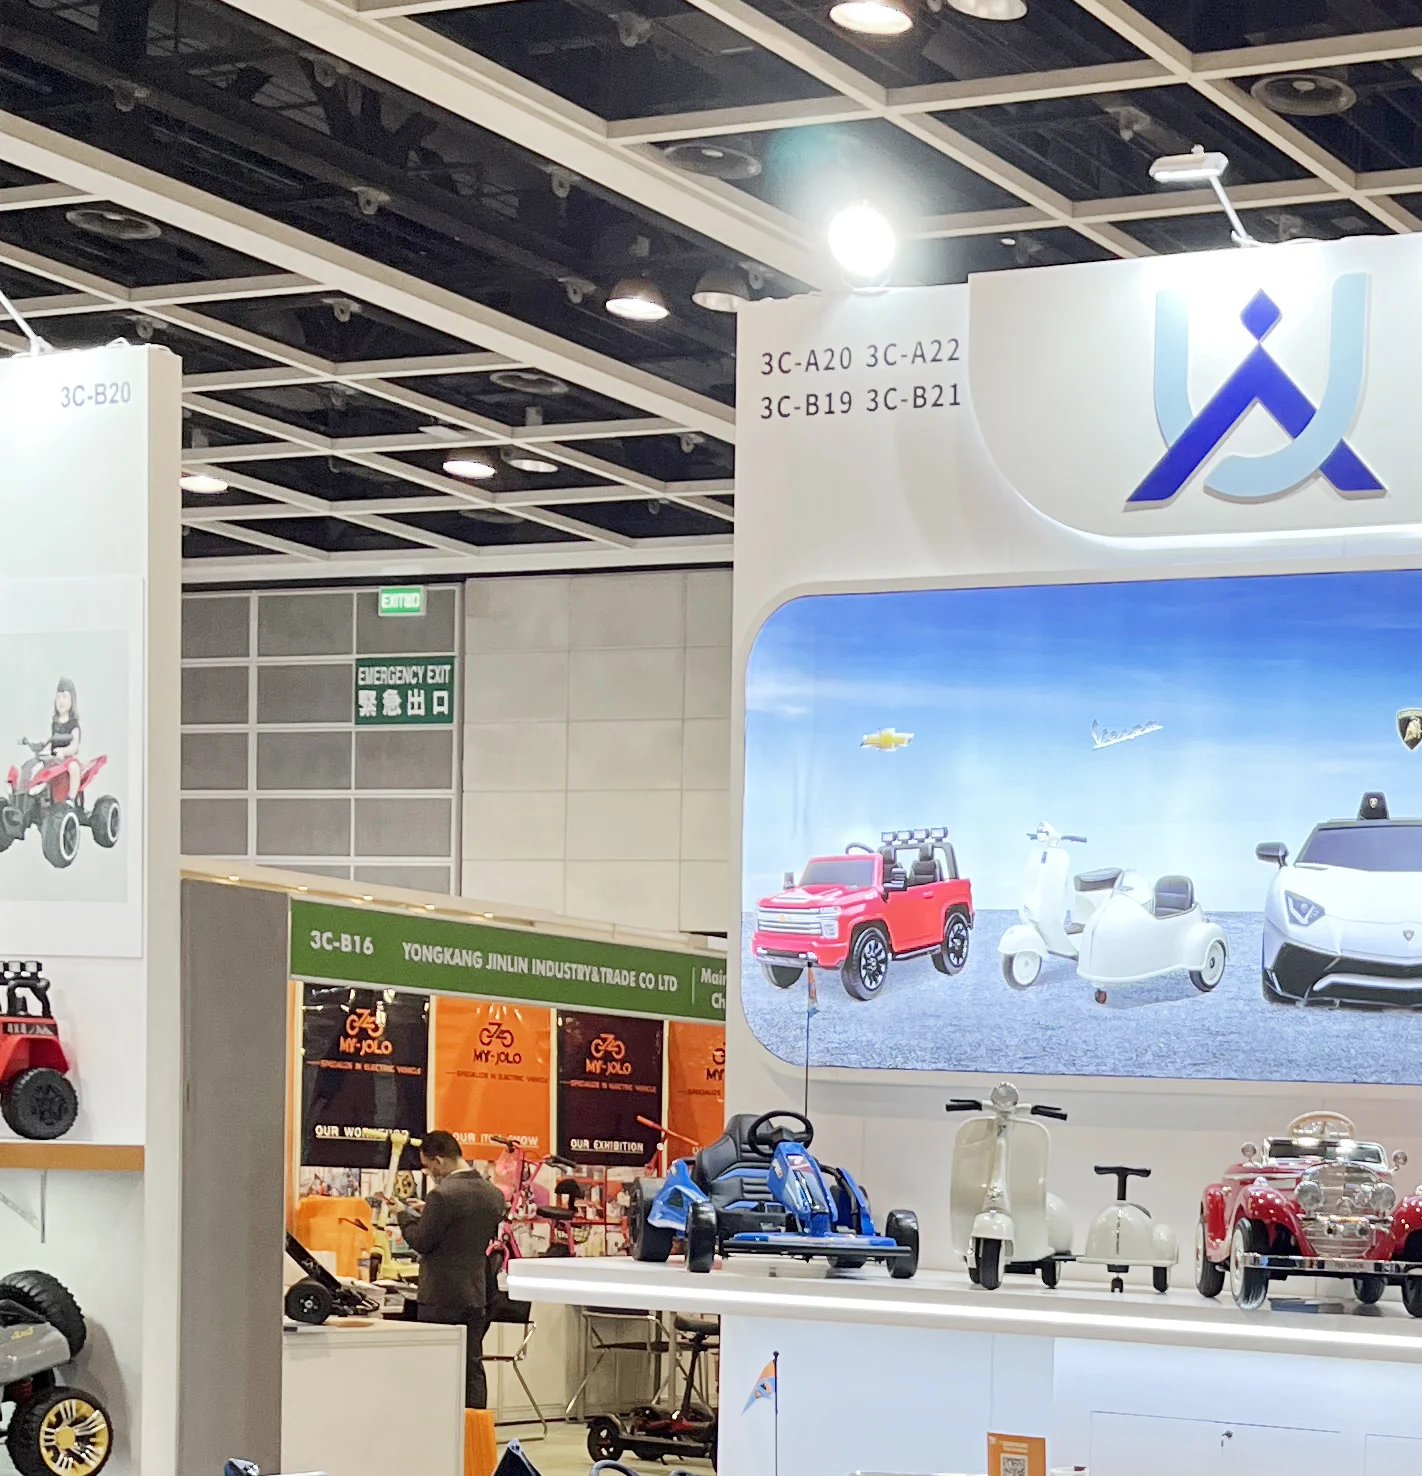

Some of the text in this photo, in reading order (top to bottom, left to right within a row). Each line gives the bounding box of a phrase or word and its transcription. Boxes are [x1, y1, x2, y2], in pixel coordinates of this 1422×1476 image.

[760, 338, 960, 376] 3C-A20 3C-A22
[61, 381, 131, 408] 3C-B20
[760, 383, 961, 419] 3C-B19 3C-B21
[358, 664, 451, 685] EMERGENCY EXIT
[309, 930, 374, 956] 3C-B16
[402, 941, 483, 969] YONGKANG
[486, 952, 529, 974] JINLIN
[532, 958, 636, 987] INDUSTRY&TRADE
[638, 972, 655, 990] CO
[658, 974, 678, 992] LTD
[315, 1124, 339, 1137] OUR
[452, 1132, 475, 1143] OUR
[570, 1139, 644, 1152] OUR EXHIBITION
